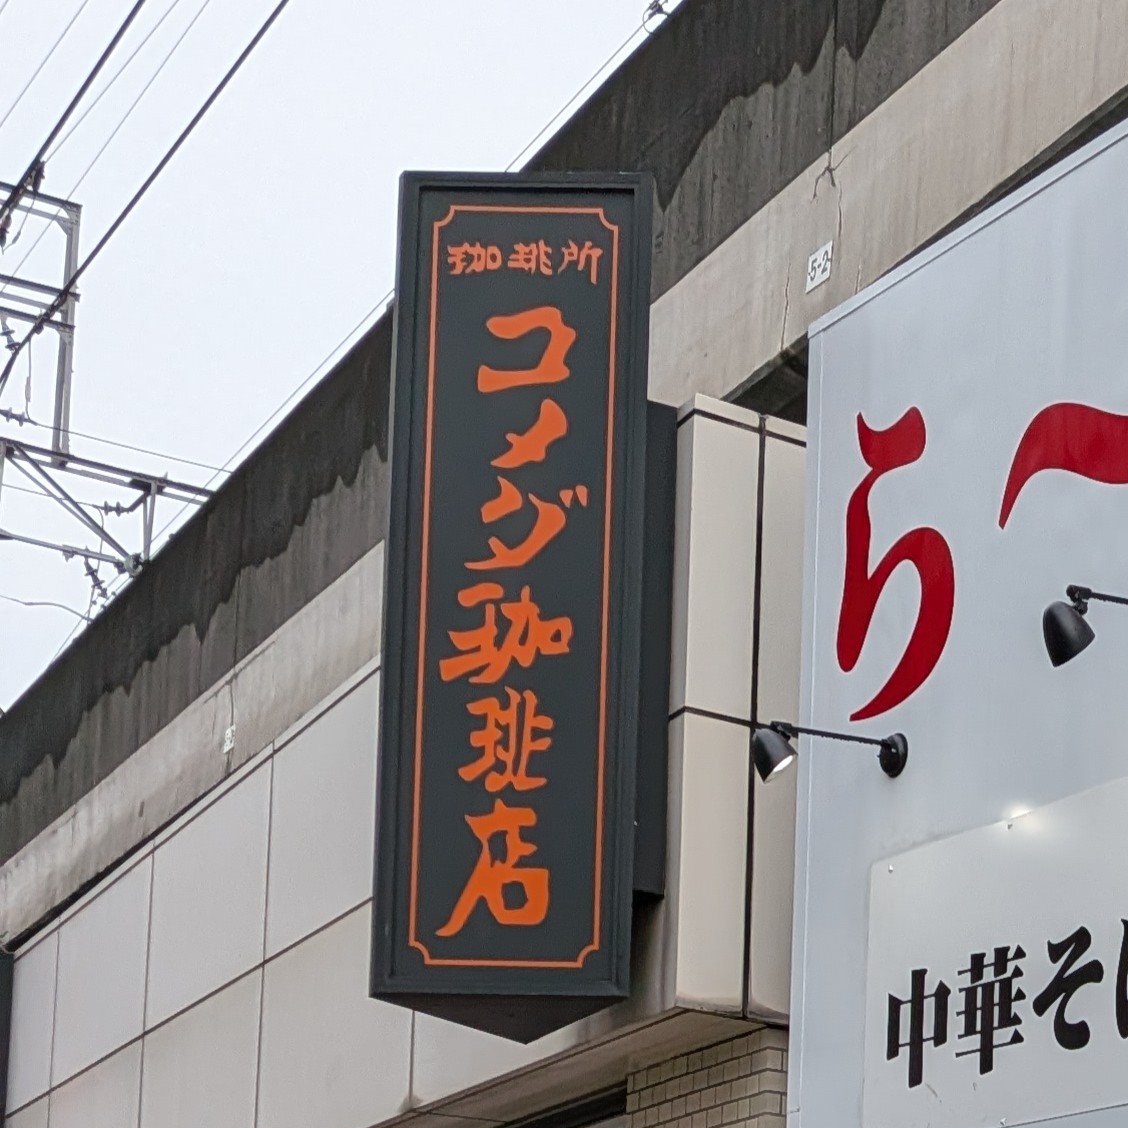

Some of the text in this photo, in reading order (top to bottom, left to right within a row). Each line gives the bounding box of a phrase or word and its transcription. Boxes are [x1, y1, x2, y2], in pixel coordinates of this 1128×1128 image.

[446, 241, 603, 285] 珈琲所
[435, 306, 588, 938] コメダ珈琲店
